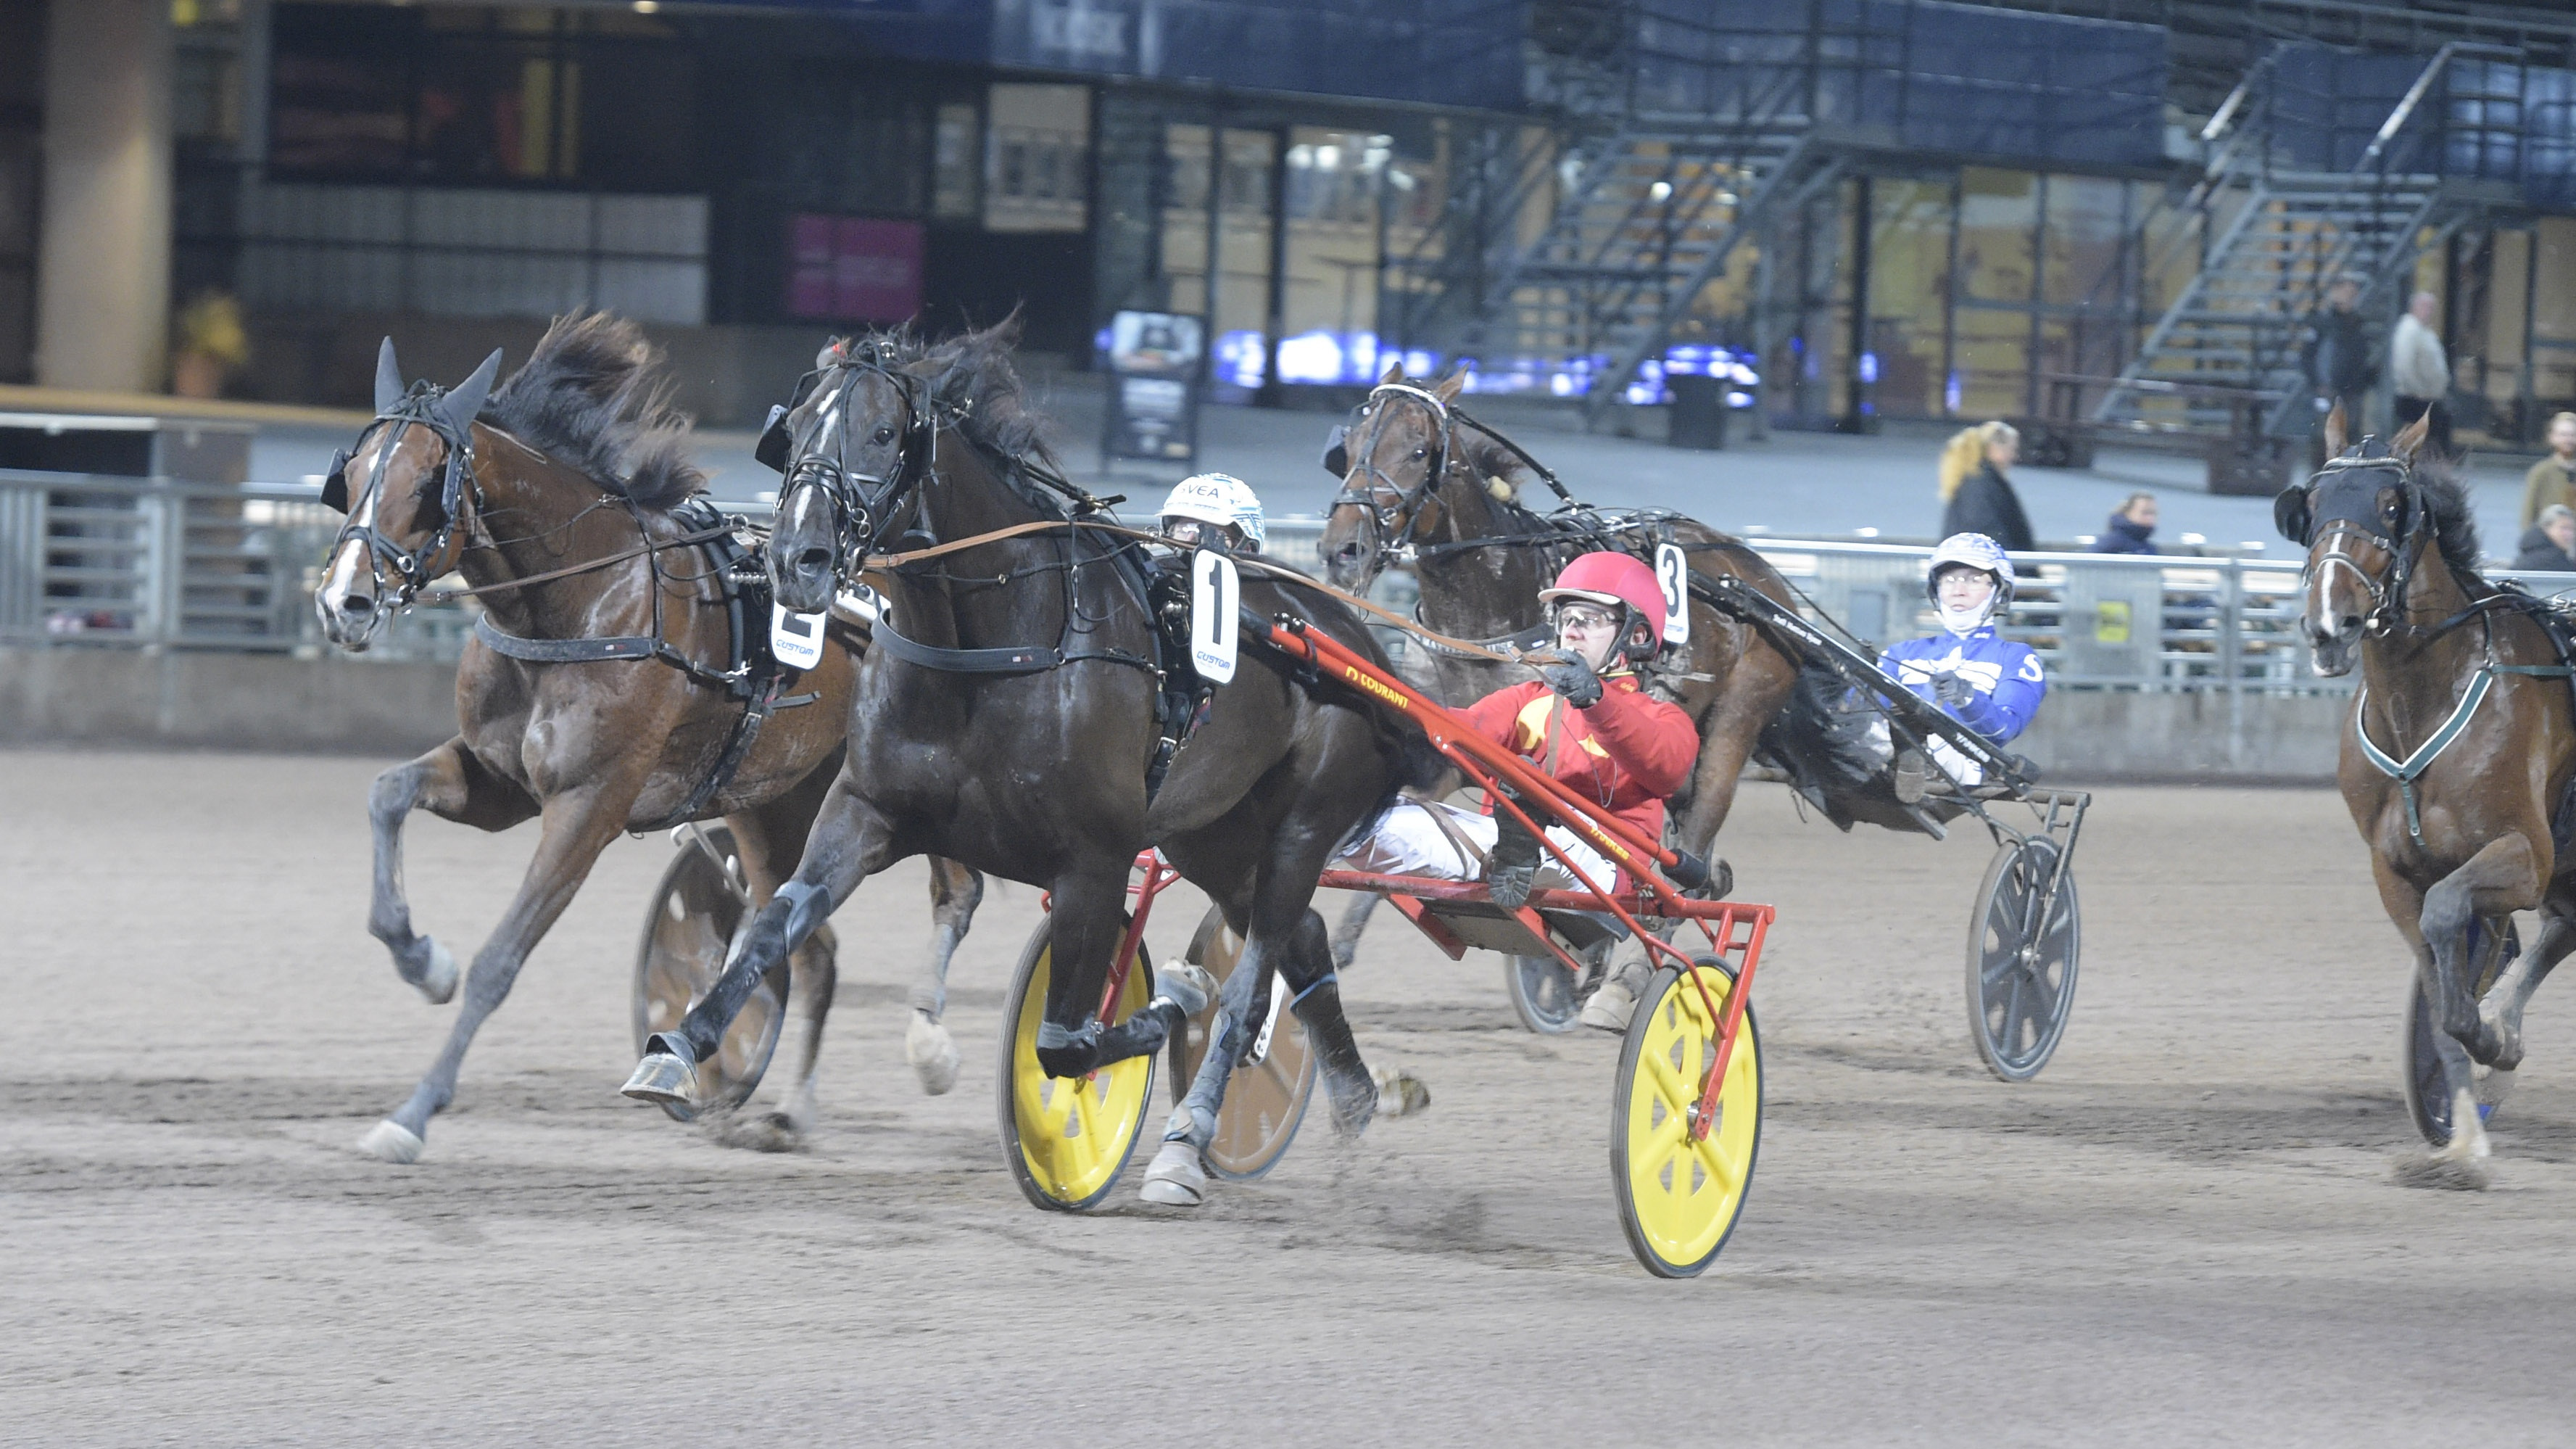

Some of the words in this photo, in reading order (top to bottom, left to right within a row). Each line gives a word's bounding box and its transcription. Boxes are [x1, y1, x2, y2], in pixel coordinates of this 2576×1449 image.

[1663, 548, 1679, 617] 3
[1209, 558, 1222, 645] 1
[776, 639, 813, 656] CUSTOM
[1197, 651, 1230, 669] CUSTOM
[1361, 673, 1409, 709] COURANT
